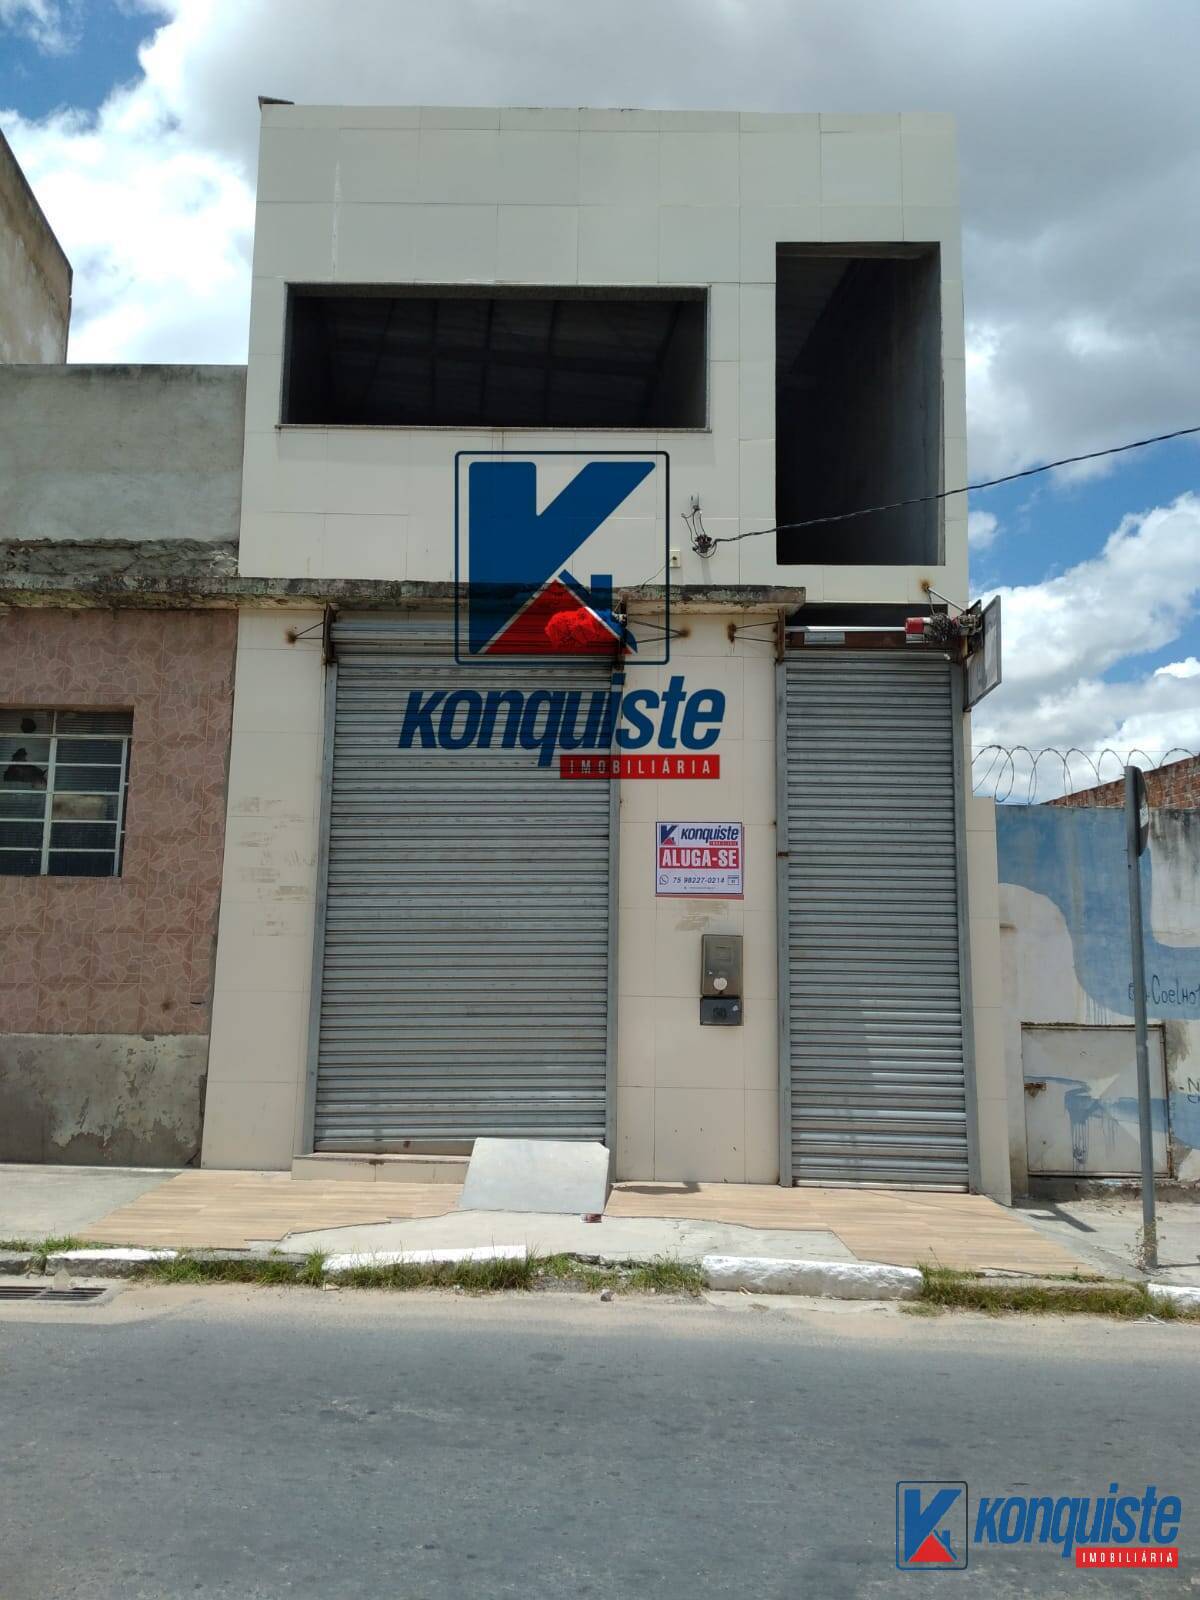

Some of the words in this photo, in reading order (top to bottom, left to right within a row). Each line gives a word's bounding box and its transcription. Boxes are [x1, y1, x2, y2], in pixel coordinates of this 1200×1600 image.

[662, 849, 737, 867] ALUGA-SE
[672, 876, 682, 884] 75
[683, 876, 725, 884] 98227-0214
